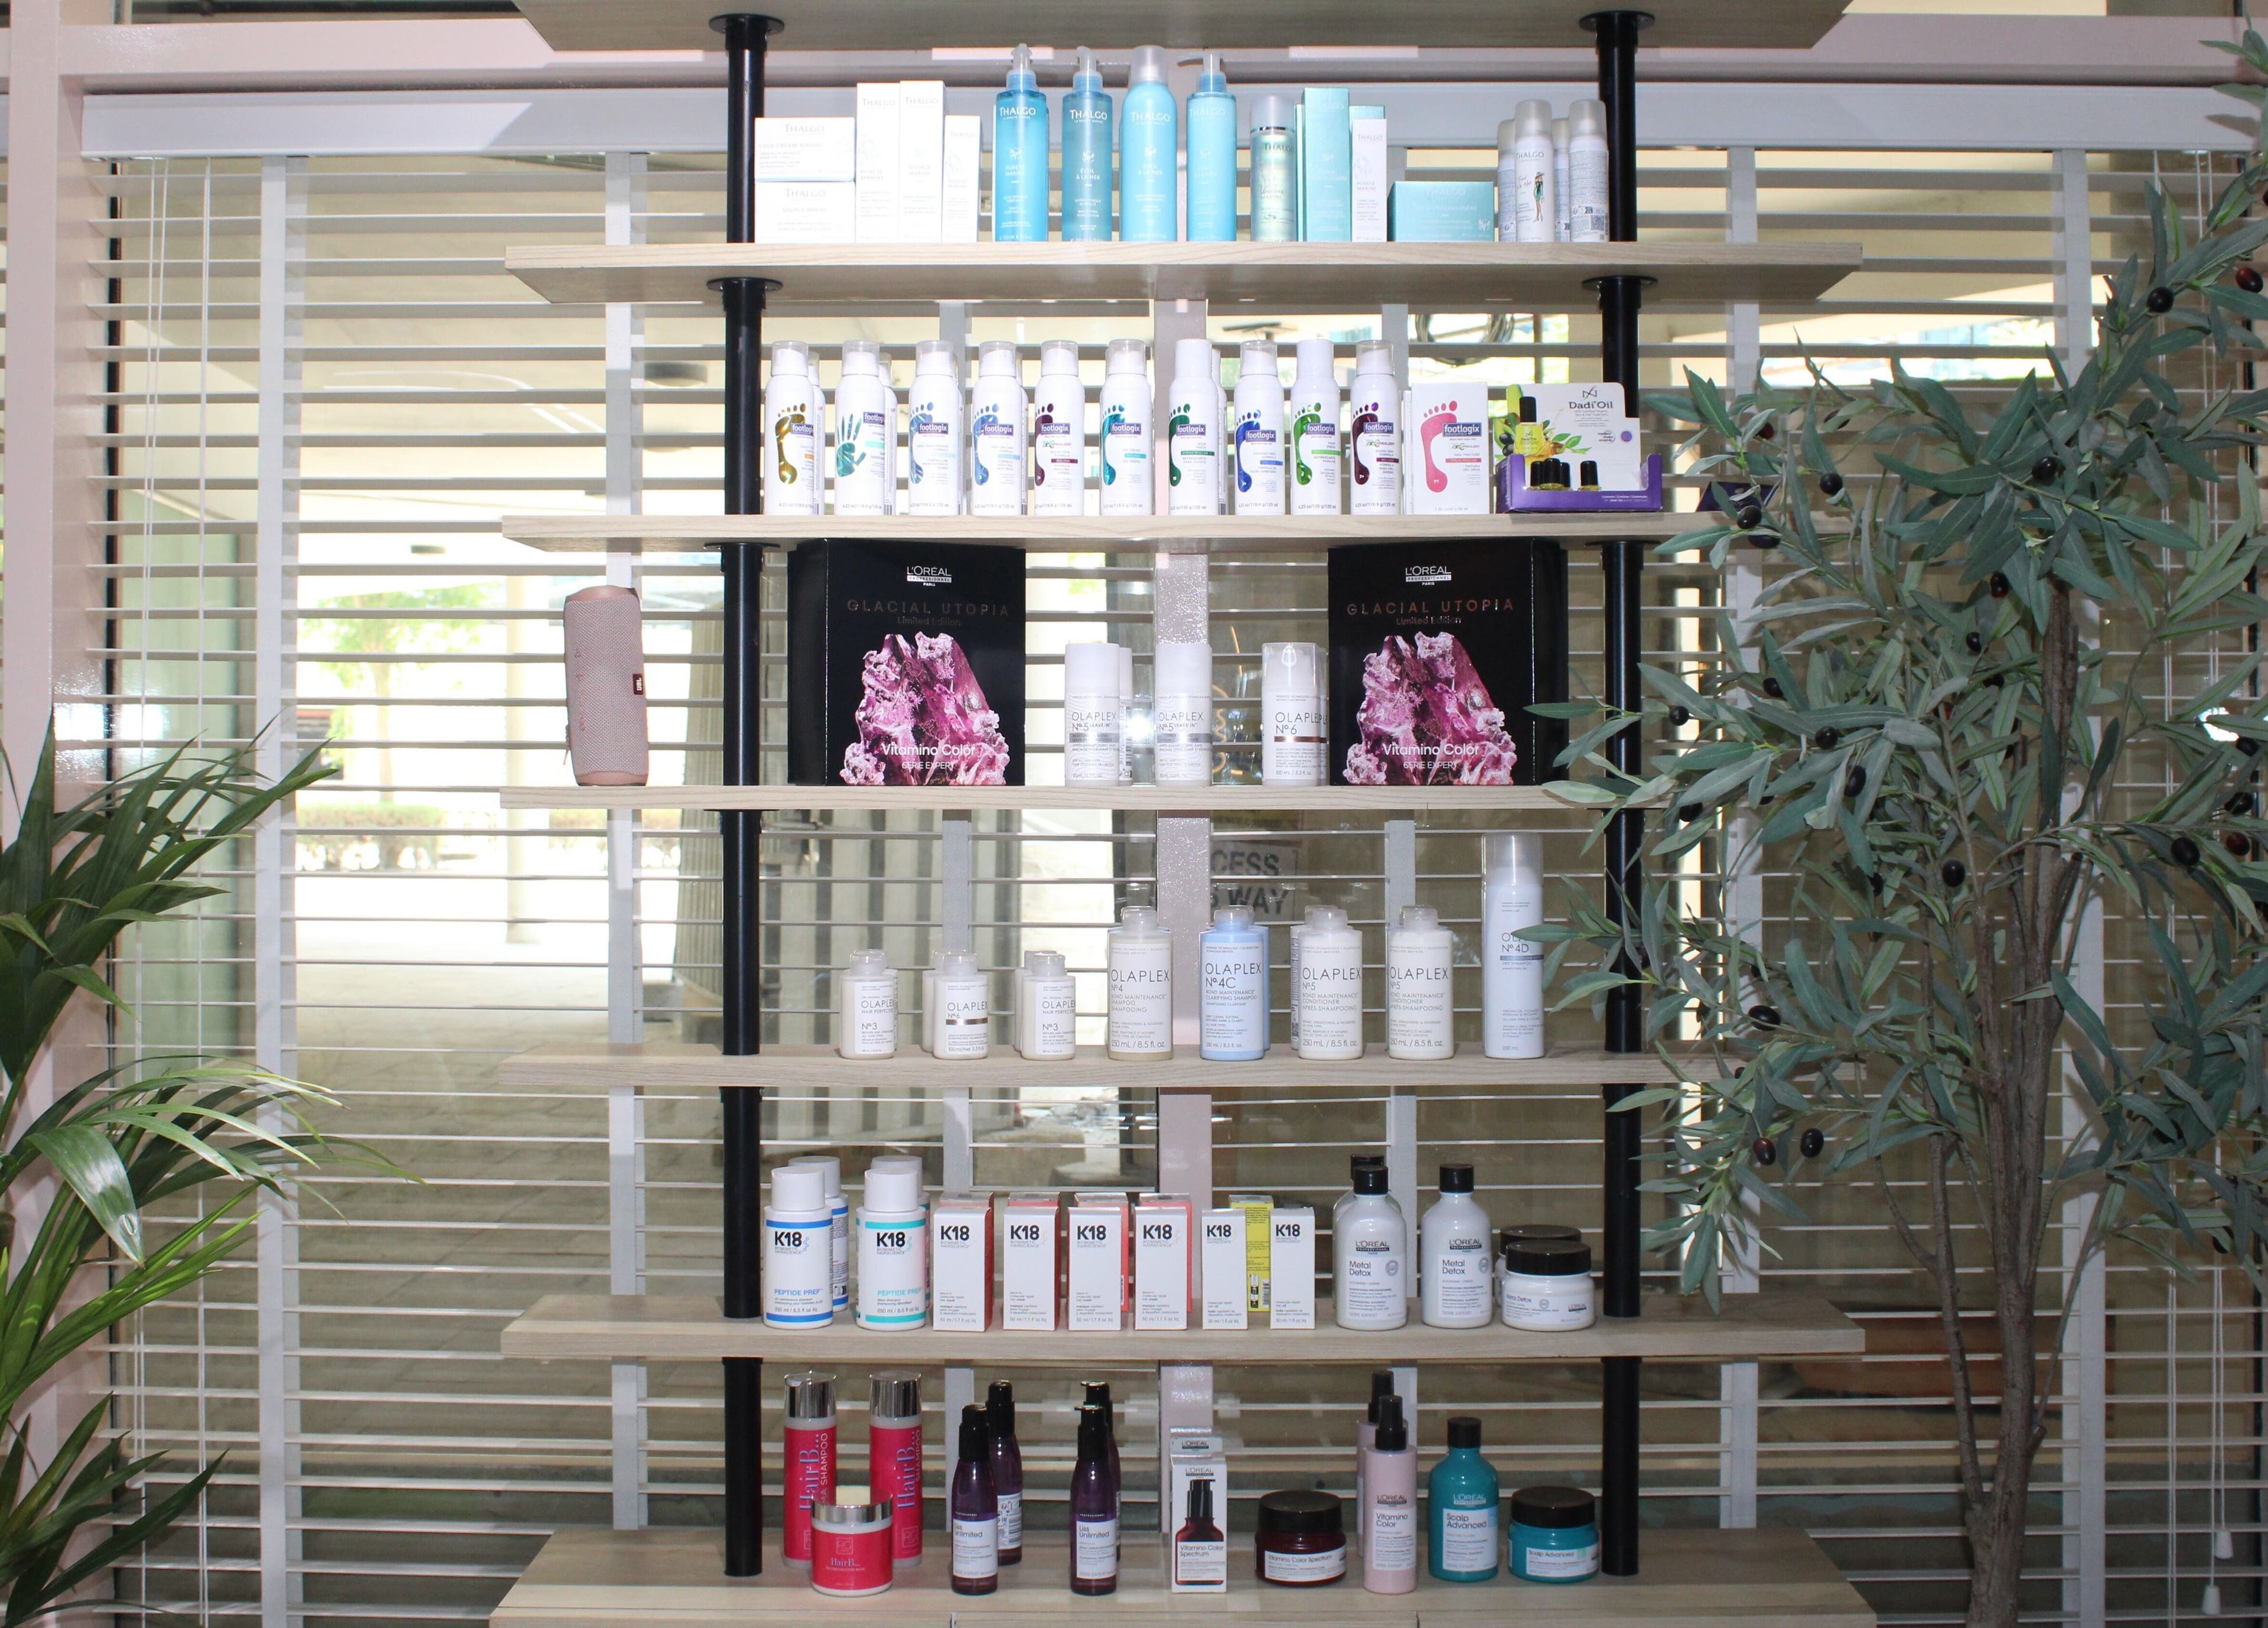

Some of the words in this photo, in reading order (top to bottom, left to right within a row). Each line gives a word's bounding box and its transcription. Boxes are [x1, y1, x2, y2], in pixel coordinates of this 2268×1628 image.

[862, 98, 895, 106] THALGO
[905, 96, 938, 105] THALGO
[999, 107, 1036, 116] THALGO
[1070, 109, 1107, 120] THALGO
[1130, 112, 1170, 122] THALGO
[784, 123, 825, 134] THALGO
[785, 188, 826, 198] THALGO
[864, 413, 884, 422] footlog
[920, 424, 948, 432] footlogix
[985, 425, 1012, 434] footlogix
[1041, 424, 1068, 432] footlogix
[1112, 424, 1141, 432] footlogix
[1177, 425, 1204, 434] footlogix
[1307, 424, 1334, 432] footlogix
[1364, 423, 1393, 432] footlogix
[1444, 424, 1480, 434] footlogix
[1247, 431, 1275, 441] footlogix
[907, 565, 951, 577] L'ORÉAL
[1406, 565, 1451, 576] L'ORÉAL
[848, 599, 930, 614] GLACIAL
[942, 603, 1009, 616] UTOPIA
[1347, 601, 1429, 616] GLACIAL
[1441, 598, 1514, 612] UTOPIA
[897, 616, 929, 626] Limited
[1396, 616, 1429, 625] Limited
[1071, 712, 1116, 721] OLAPLEX
[1159, 712, 1204, 721] OLAPLEX
[1275, 712, 1319, 723] OLAPLE
[882, 742, 939, 756] Vitamino
[942, 744, 976, 756] Color
[1383, 742, 1440, 756] Vitamino
[1443, 743, 1479, 756] Color
[1427, 761, 1458, 769] EXPERT
[1211, 850, 1279, 876] CESS
[1227, 886, 1288, 914] WAY
[1205, 962, 1262, 975] OLAPLEX
[1390, 966, 1448, 980] OLAPLEX
[1111, 969, 1170, 982] OLAPLEX
[1302, 968, 1361, 980] OLAPLEX
[1112, 1040, 1120, 1048] 250
[1138, 1040, 1148, 1048] 8.5
[1302, 1038, 1312, 1047] 250
[1331, 1038, 1342, 1047] 8.5
[1415, 1038, 1426, 1047] 8.5
[941, 1225, 970, 1240] K18
[1011, 1225, 1040, 1240] K18
[1077, 1225, 1106, 1240] K18
[1143, 1225, 1172, 1239] K18
[1207, 1225, 1231, 1237] K18
[1276, 1224, 1301, 1237] K18
[775, 1231, 802, 1247] K18
[877, 1232, 905, 1247] K18
[1447, 1513, 1469, 1522] Scalp
[1308, 1554, 1332, 1562] Spectrum
